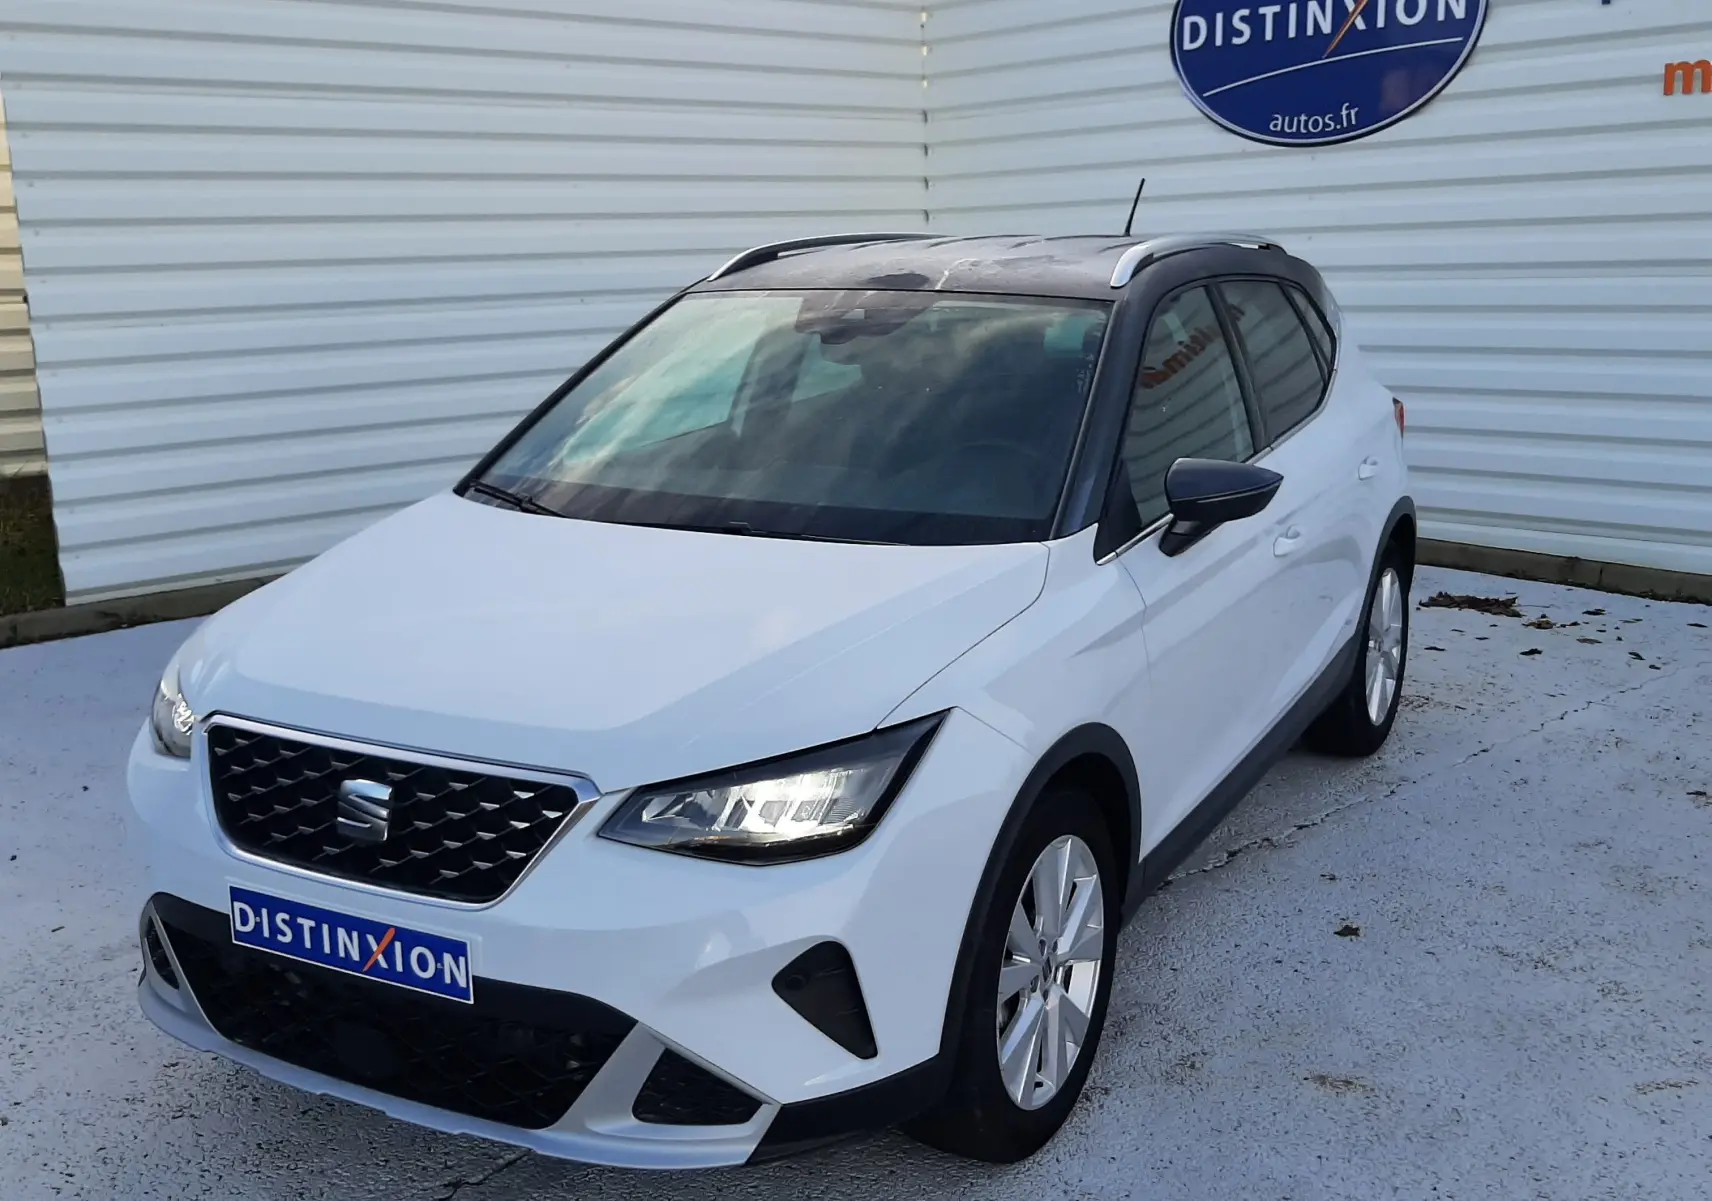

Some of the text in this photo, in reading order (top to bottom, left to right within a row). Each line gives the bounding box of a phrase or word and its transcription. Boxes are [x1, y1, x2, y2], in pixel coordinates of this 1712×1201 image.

[1183, 0, 1466, 54] DISTINXION
[1269, 103, 1360, 133] autos.fr
[233, 901, 467, 988] DISTINXION
